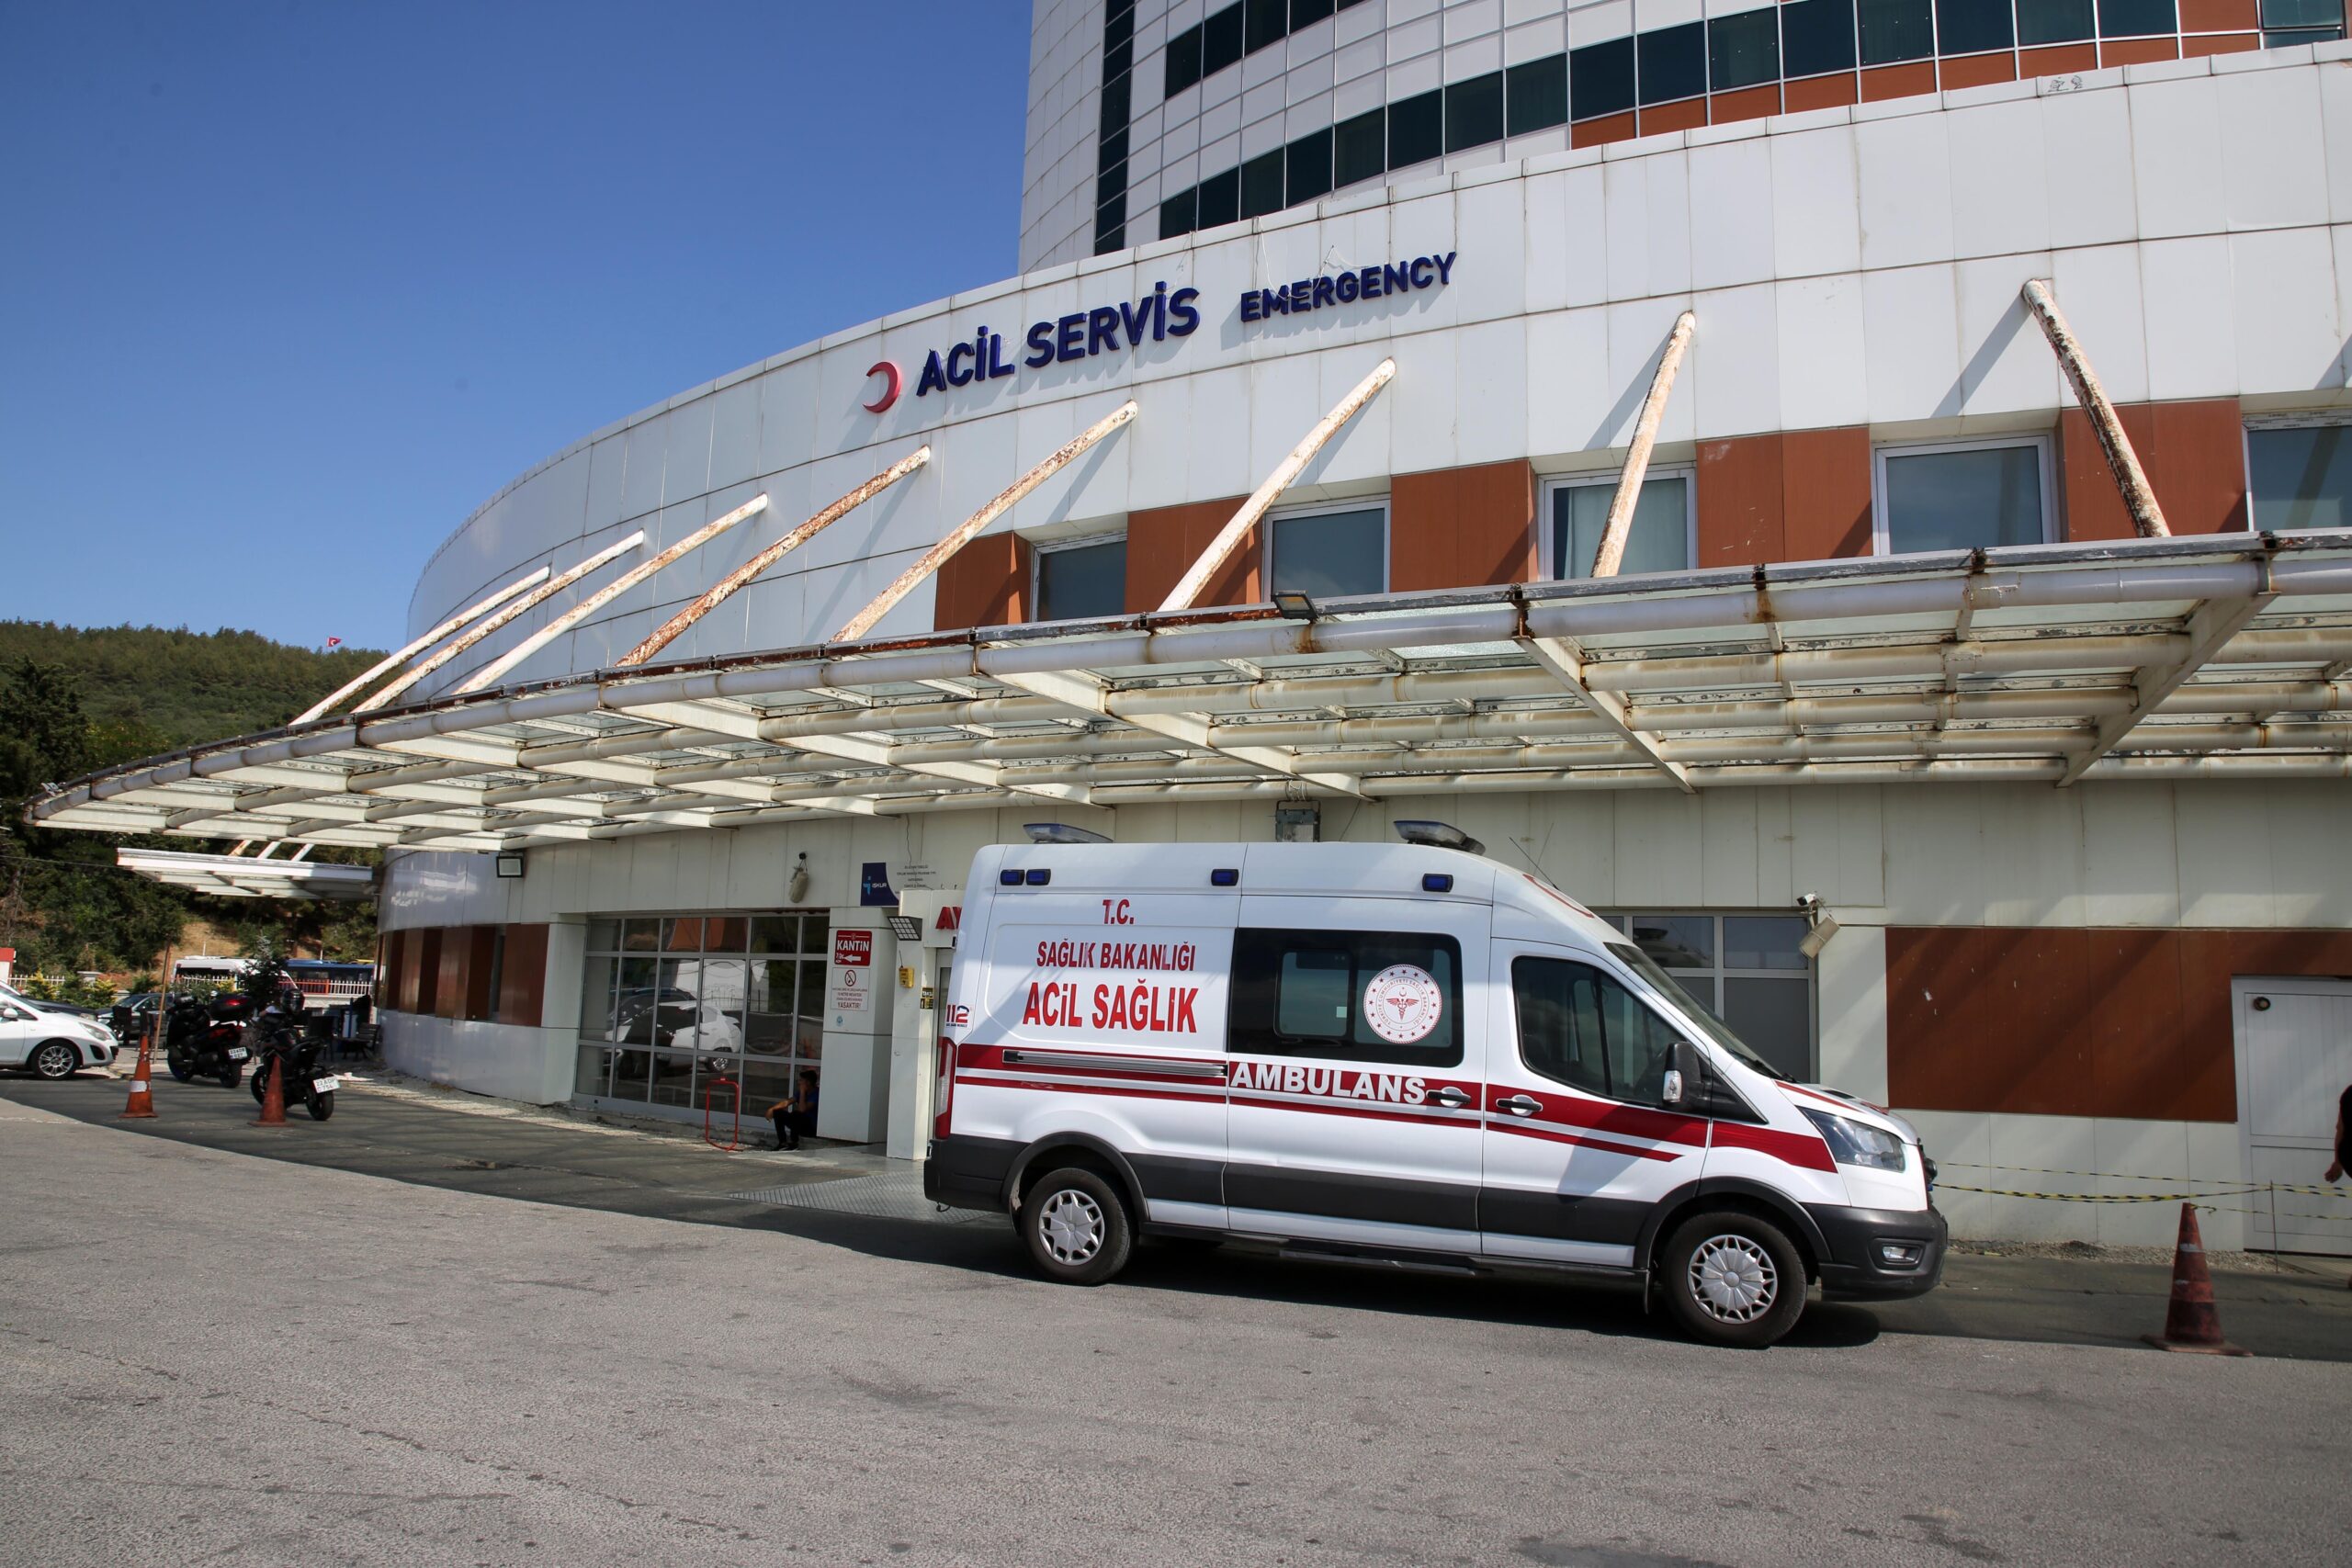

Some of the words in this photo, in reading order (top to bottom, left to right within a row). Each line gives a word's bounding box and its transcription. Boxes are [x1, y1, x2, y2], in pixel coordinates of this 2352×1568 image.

[1240, 251, 1457, 322] EMERGENCY
[916, 325, 1014, 397] ACİL
[1024, 280, 1201, 368] SERVİS
[1102, 899, 1135, 925] T.C.
[1036, 938, 1096, 968] SAĞLIK
[1100, 941, 1196, 972] BAKANLIĞI
[946, 1005, 969, 1023] 112
[1091, 977, 1199, 1033] SAĞLIK
[1230, 1062, 1426, 1104] AMBULANS
